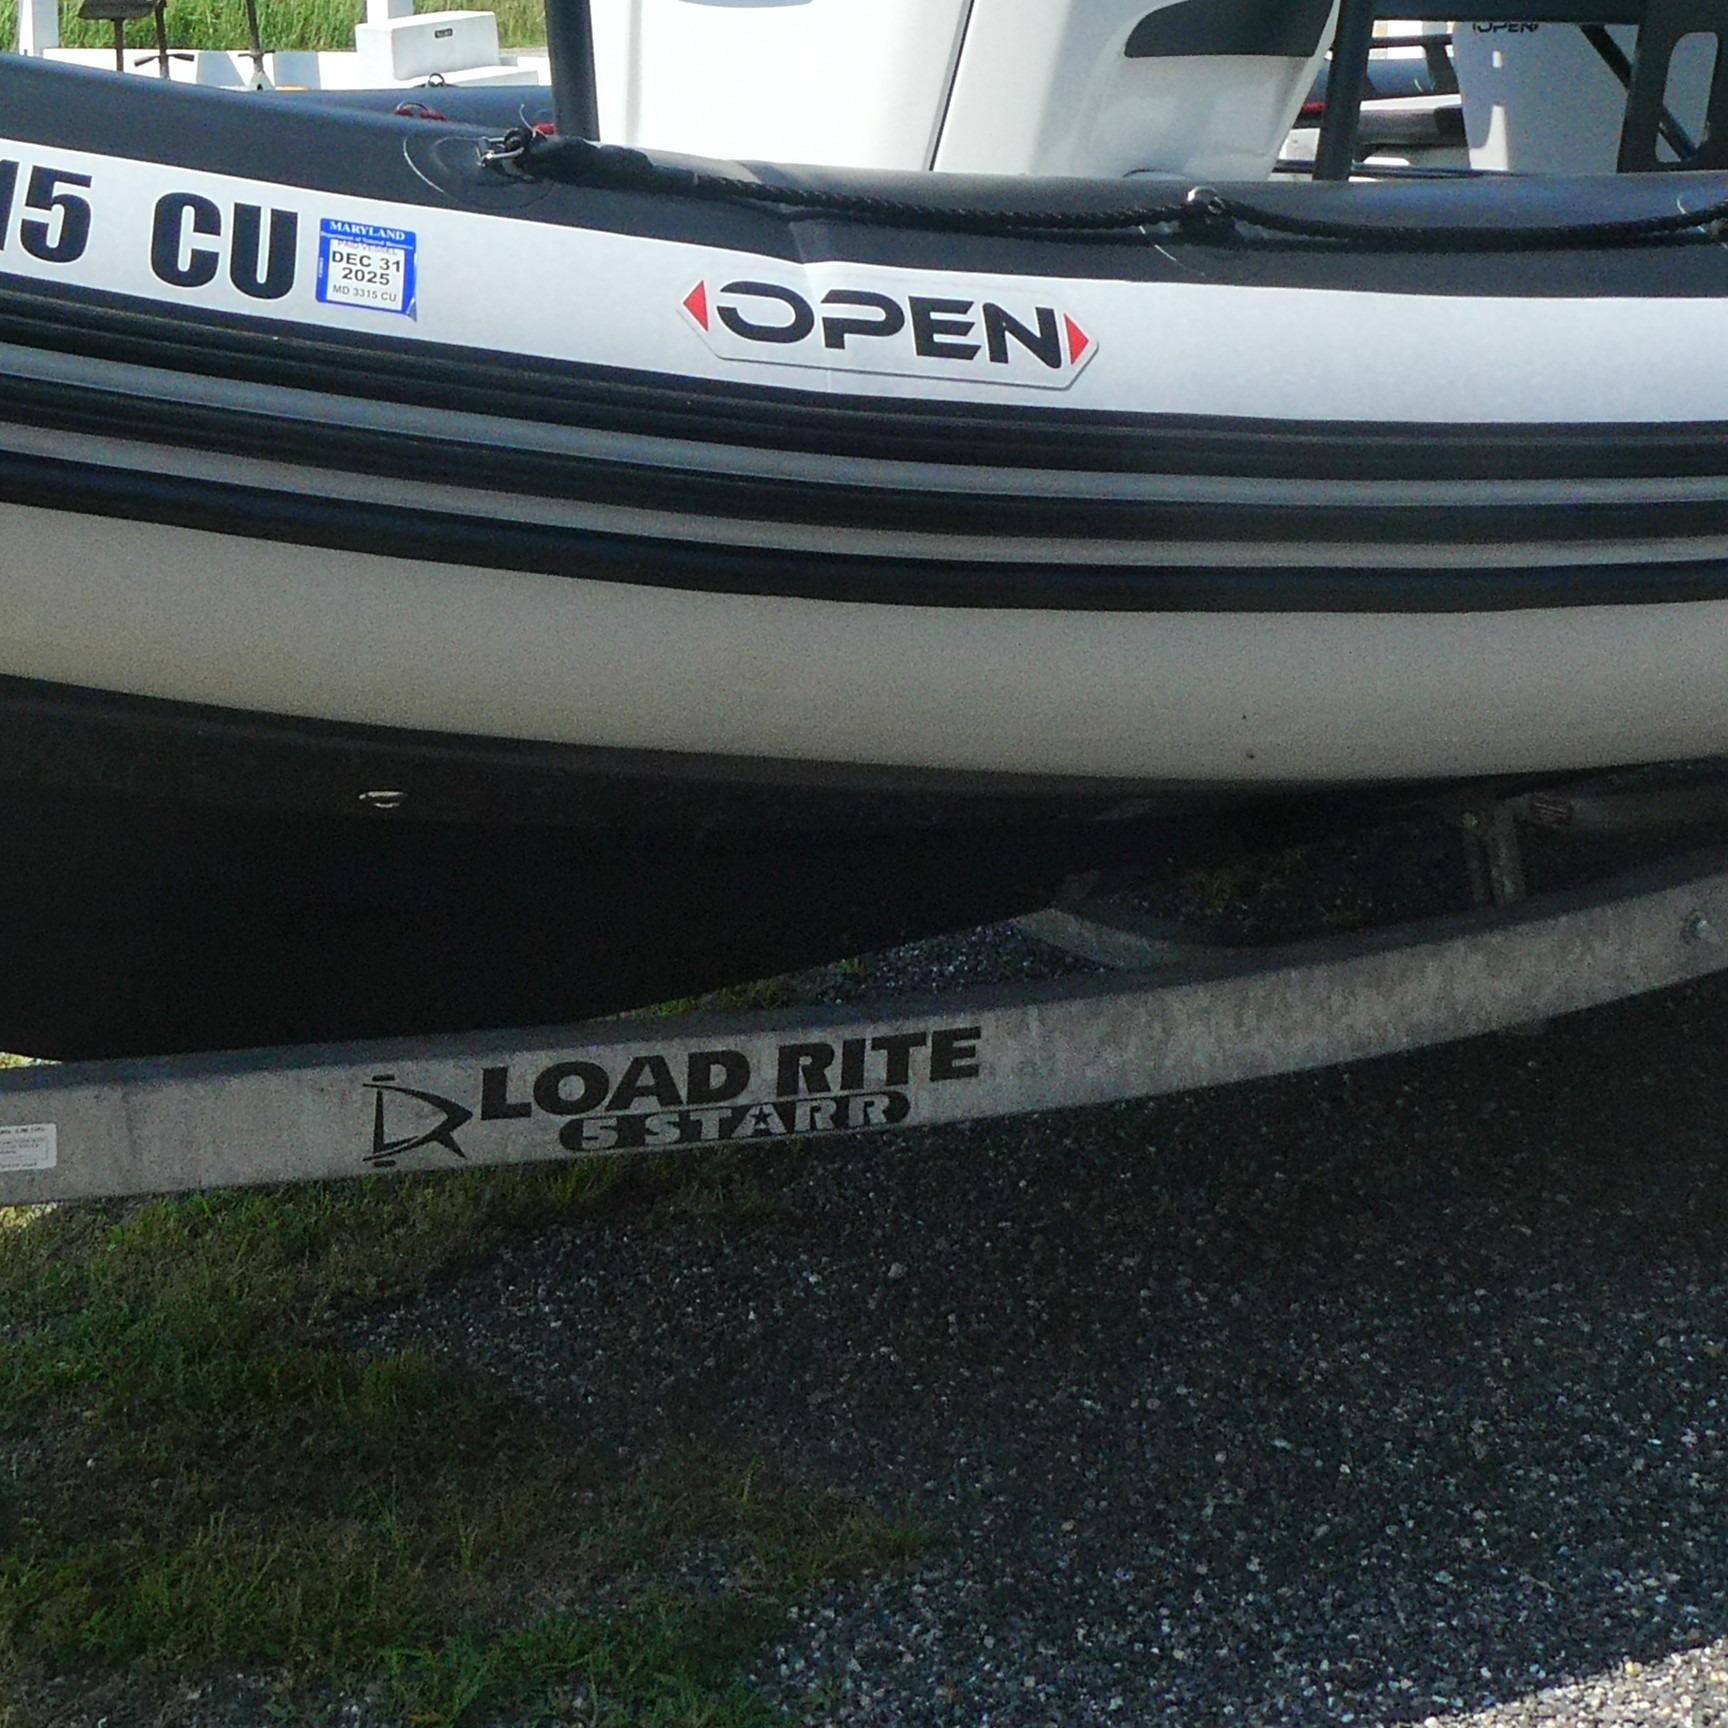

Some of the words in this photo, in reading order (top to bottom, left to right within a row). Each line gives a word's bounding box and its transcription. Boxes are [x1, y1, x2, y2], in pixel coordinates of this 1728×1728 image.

[150, 192, 299, 301] CU
[329, 220, 406, 241] MARYLAND
[332, 251, 372, 268] DEC
[379, 258, 401, 273] 31
[341, 267, 390, 286] 2025
[332, 285, 350, 296] MD
[353, 287, 378, 300] 3315
[380, 292, 397, 303] CU
[716, 280, 1063, 370] OPEN
[479, 1049, 752, 1121] LOAD
[776, 1026, 982, 1097] RITE
[580, 1116, 620, 1150] 5
[644, 1090, 896, 1148] STARR
